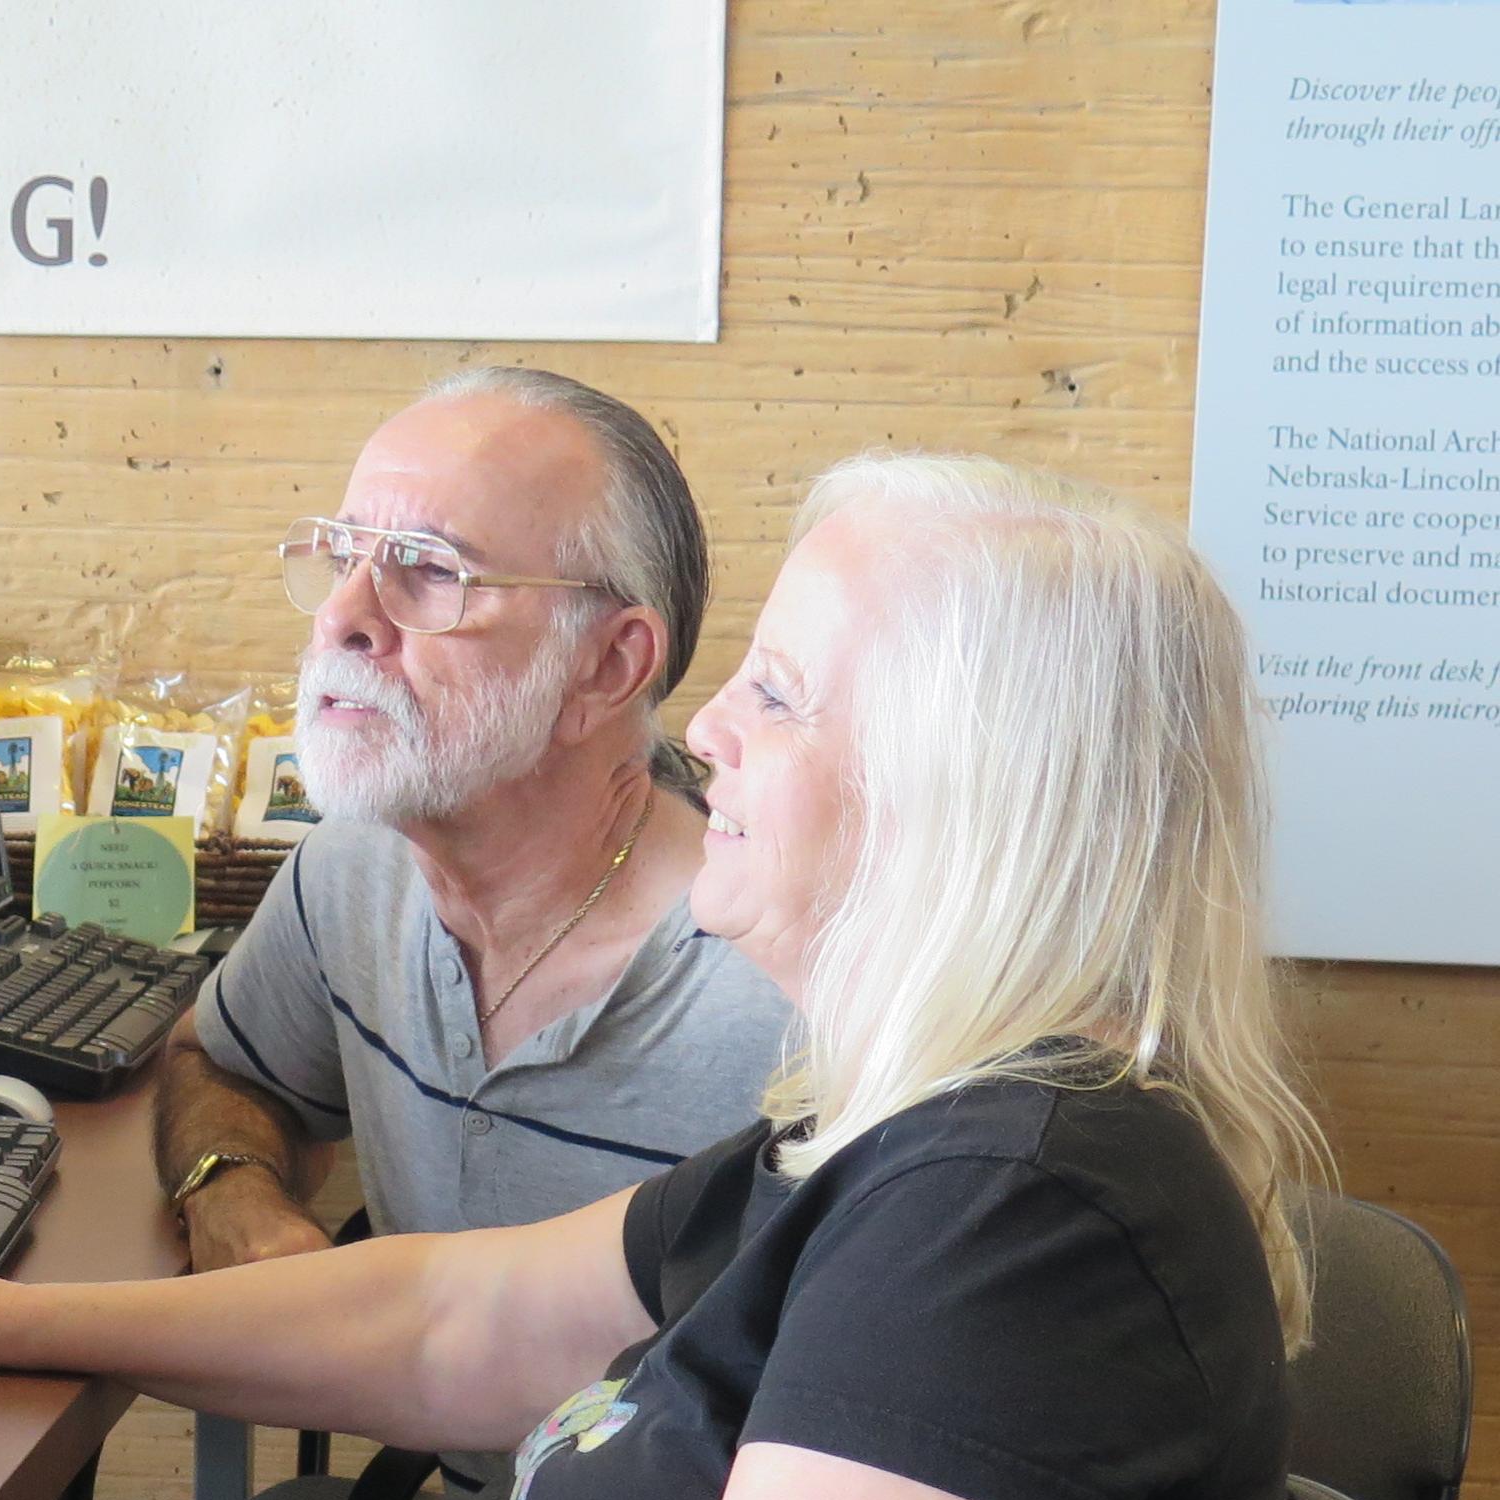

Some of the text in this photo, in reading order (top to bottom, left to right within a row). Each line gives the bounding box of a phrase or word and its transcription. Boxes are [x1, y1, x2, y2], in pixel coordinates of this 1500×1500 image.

[1289, 77, 1500, 109] Discover the peo
[1286, 117, 1385, 147] through
[1393, 118, 1454, 142] their
[1282, 194, 1334, 219] The
[1343, 195, 1449, 220] General
[1280, 235, 1500, 260] to ensure that th
[1277, 272, 1500, 302] legal requiremen
[1275, 310, 1500, 337] of information ab
[1273, 350, 1320, 374] and
[1329, 350, 1368, 374] the
[1375, 356, 1469, 376] success
[1269, 425, 1319, 450] The
[1327, 427, 1436, 453] National
[1267, 464, 1500, 492] Nebraska-Lincoln
[1264, 502, 1358, 528] Service
[1365, 511, 1405, 529] are
[1262, 544, 1287, 563] to
[1295, 547, 1405, 570] preserve
[1413, 545, 1460, 568] and
[1260, 578, 1378, 604] historical
[1258, 653, 1309, 677] Visit
[1316, 656, 1353, 679] the
[1355, 656, 1422, 685] front
[1429, 659, 1484, 682] desk
[1262, 692, 1500, 727] xploring this micro
[88, 880, 140, 889] POPCORN
